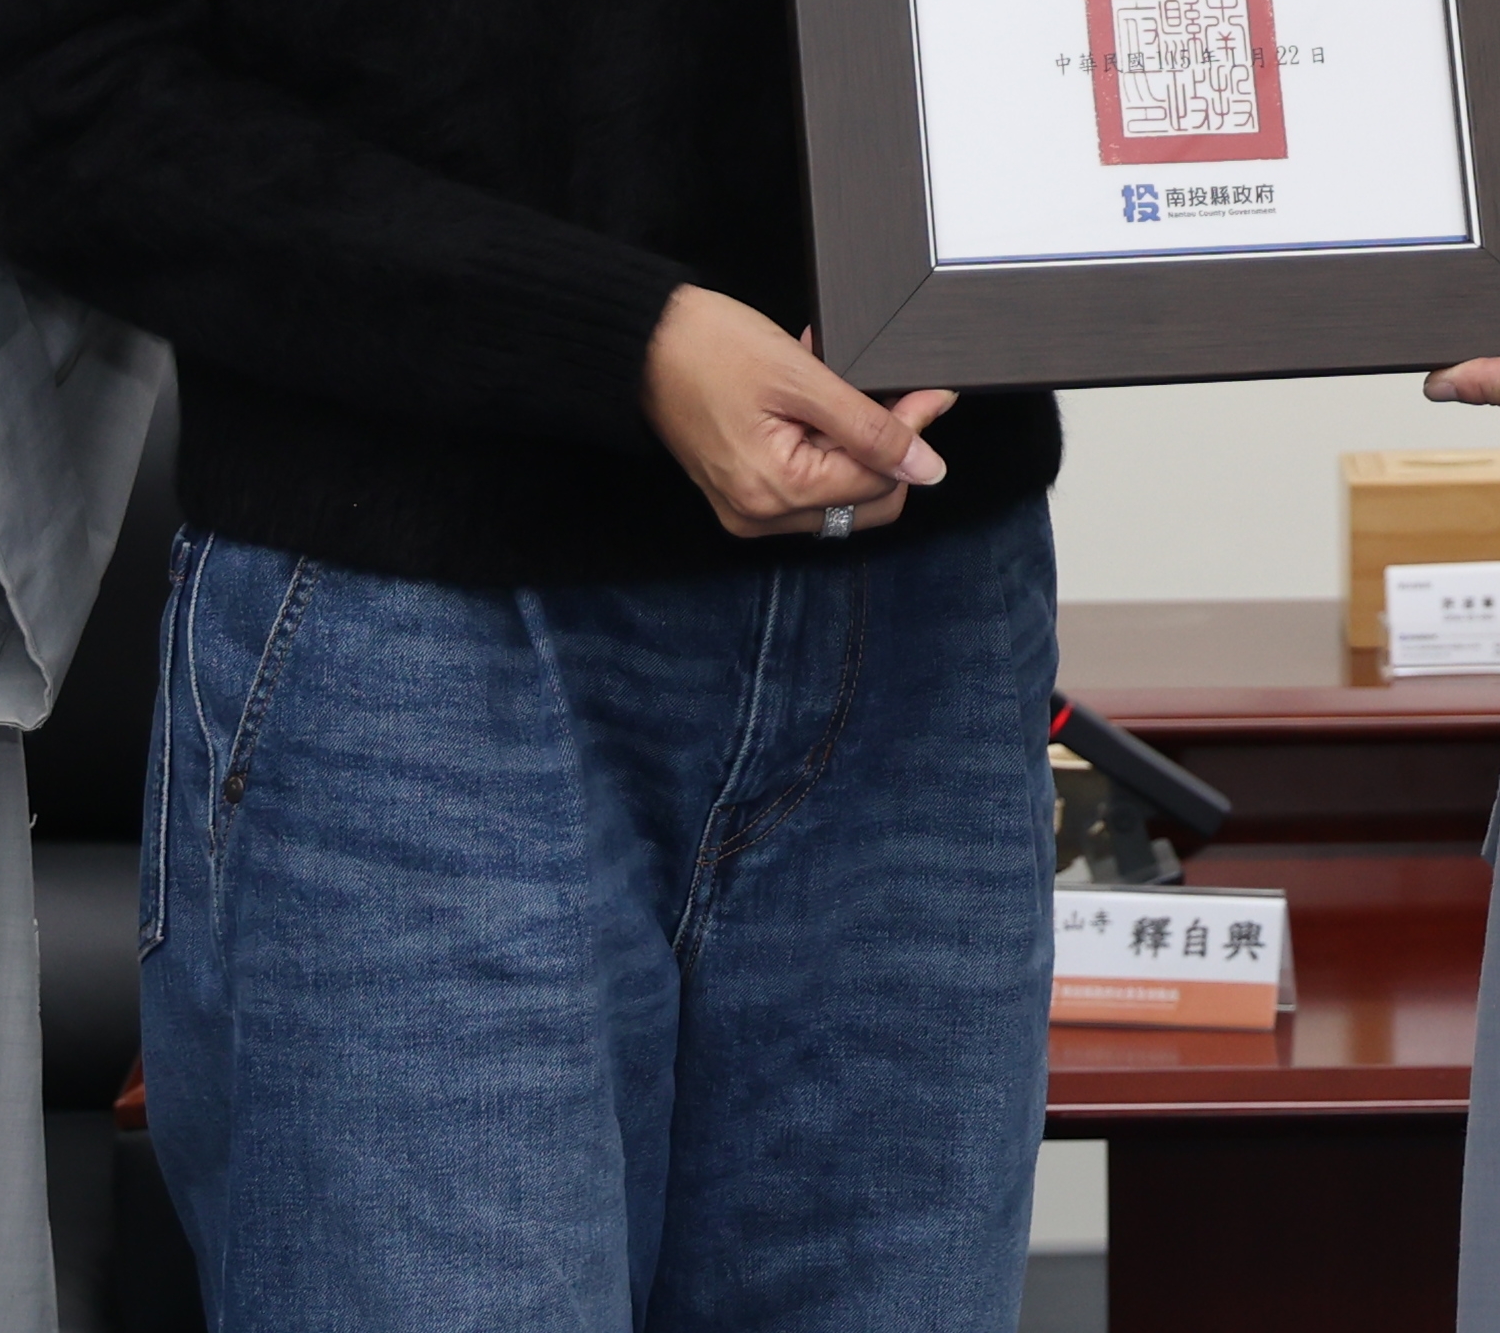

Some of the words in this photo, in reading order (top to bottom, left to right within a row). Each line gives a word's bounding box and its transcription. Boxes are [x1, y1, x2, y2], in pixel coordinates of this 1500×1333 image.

[1165, 183, 1275, 208] 南投縣政府
[1198, 208, 1227, 219] County
[1228, 206, 1277, 216] Government
[1053, 909, 1112, 934] 山寺
